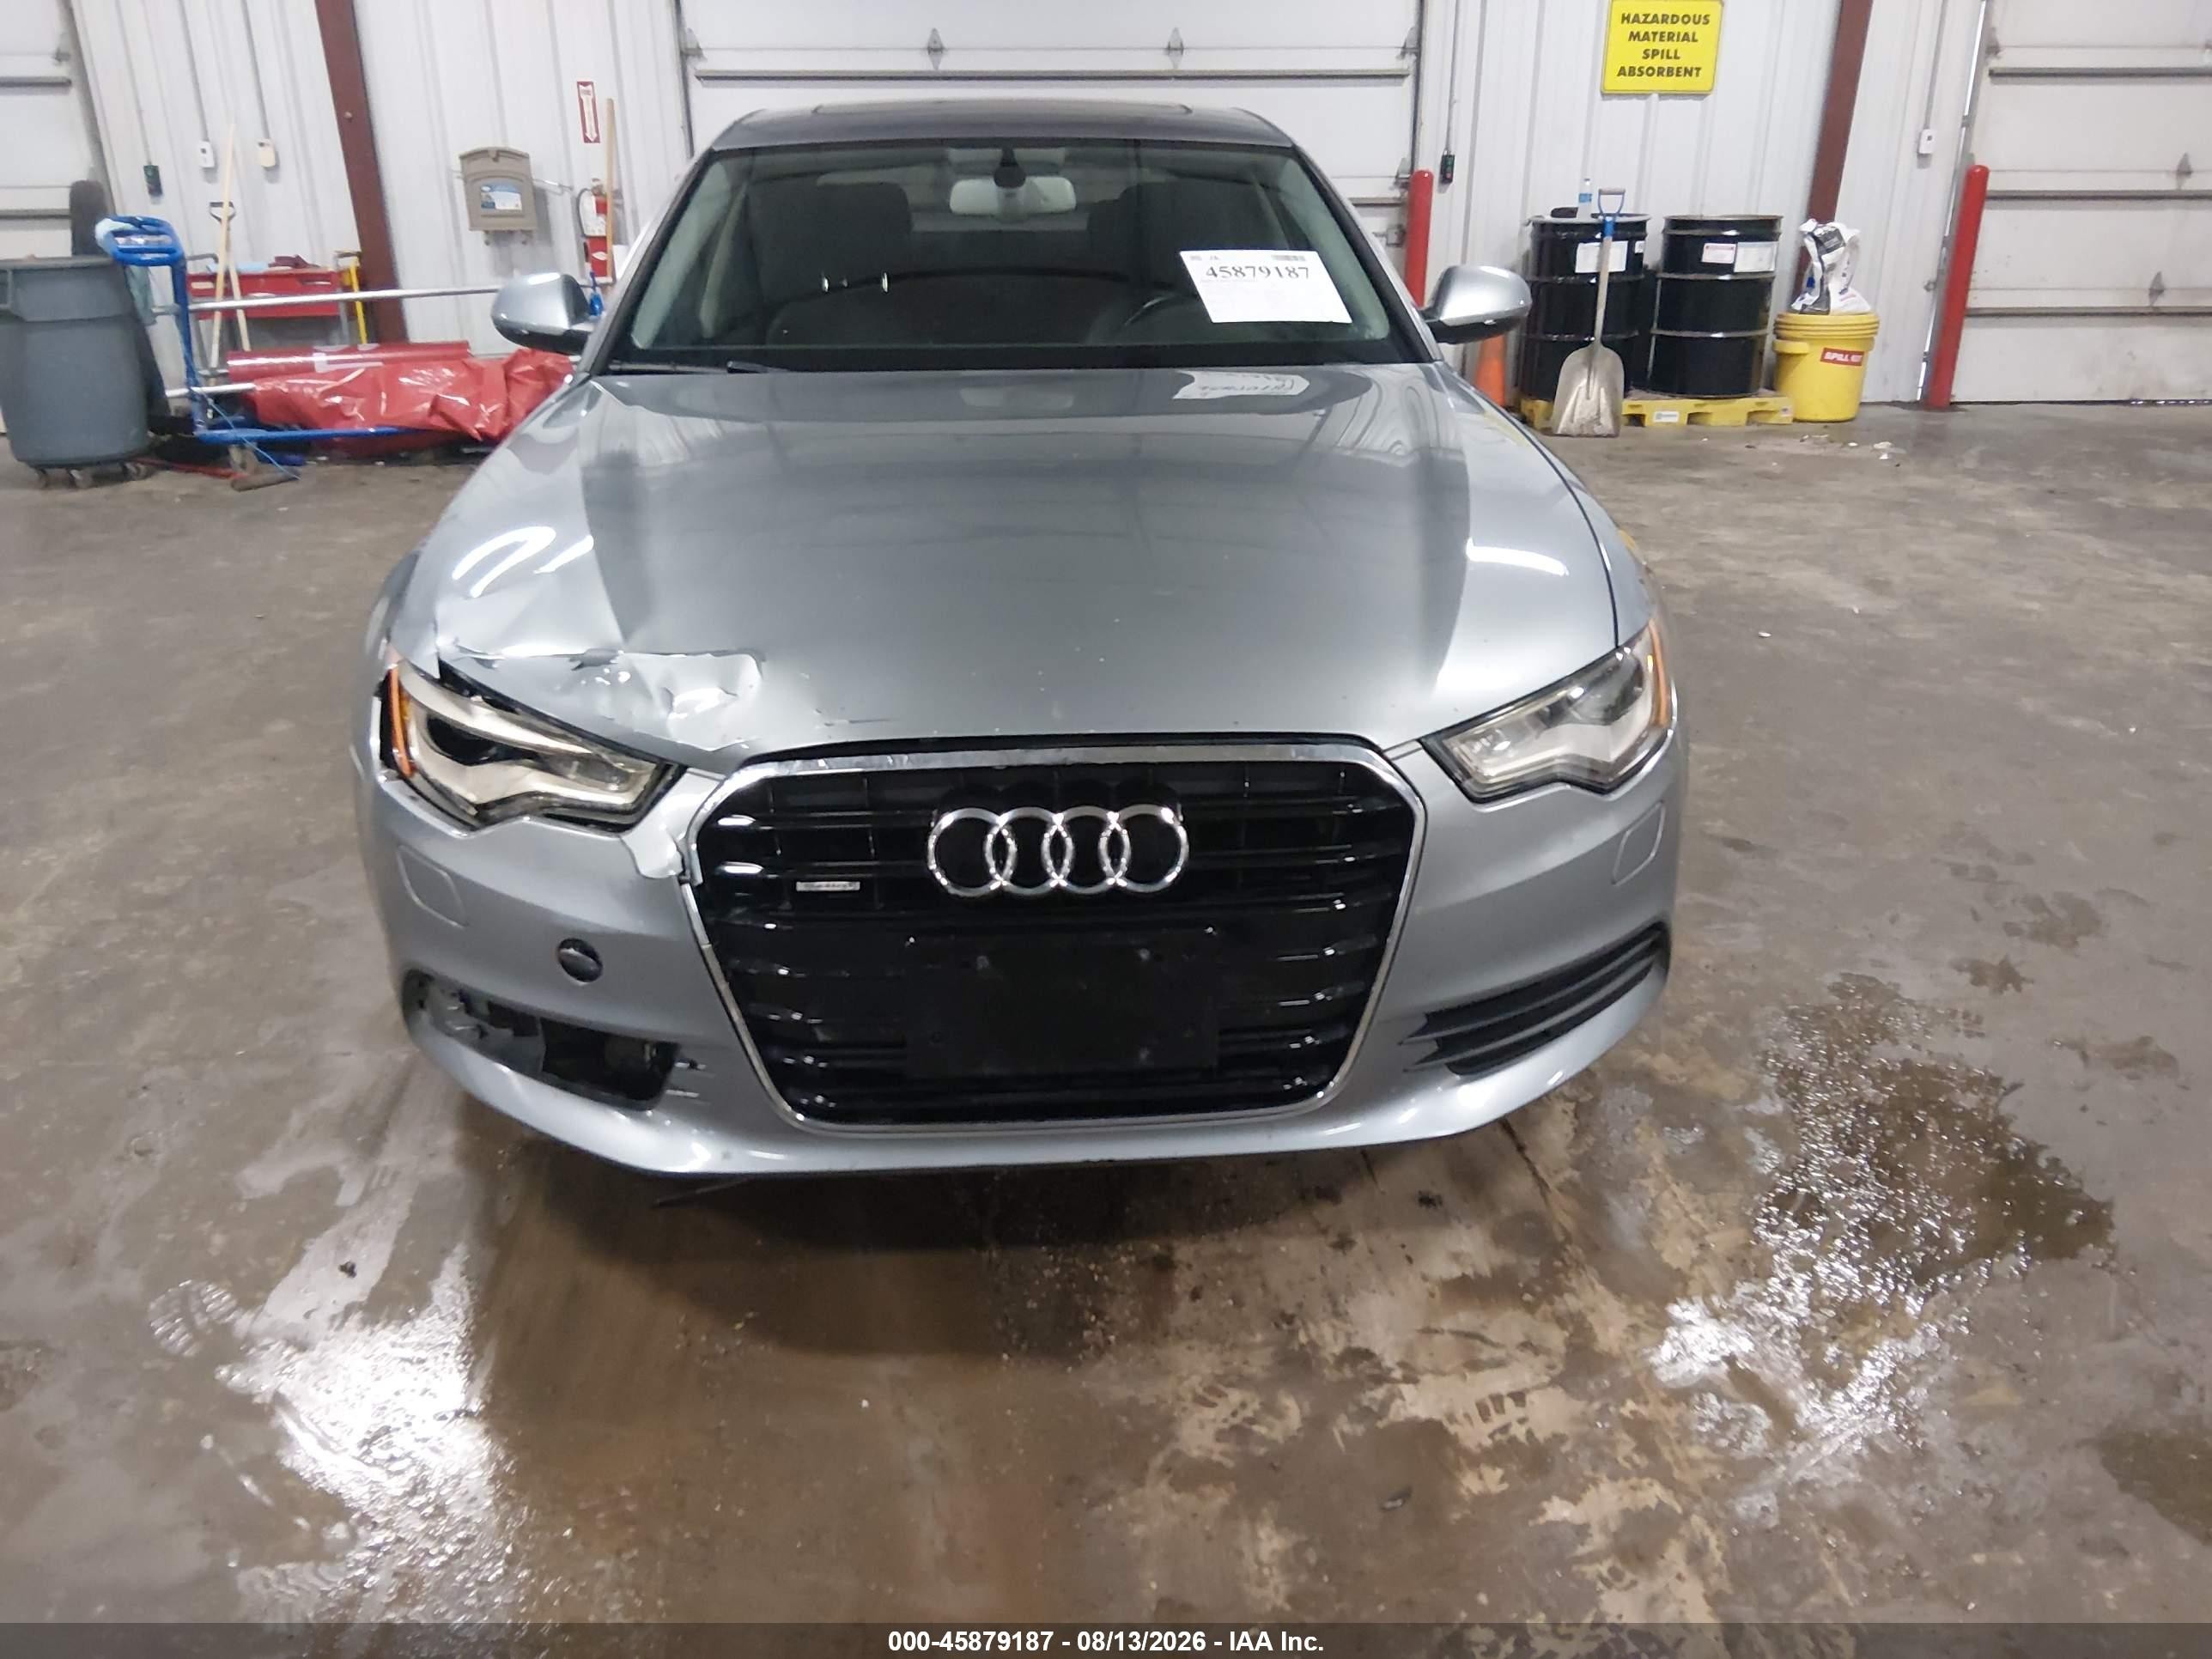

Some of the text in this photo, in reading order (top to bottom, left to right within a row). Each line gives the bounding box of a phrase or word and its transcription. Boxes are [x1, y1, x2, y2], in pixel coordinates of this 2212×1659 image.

[1620, 13, 1711, 25] HAZARDOUS
[1627, 31, 1698, 43] MATERIAL
[1642, 48, 1680, 59] SPILL
[1616, 66, 1702, 77] ABSORBENT
[1206, 265, 1310, 279] 45879187
